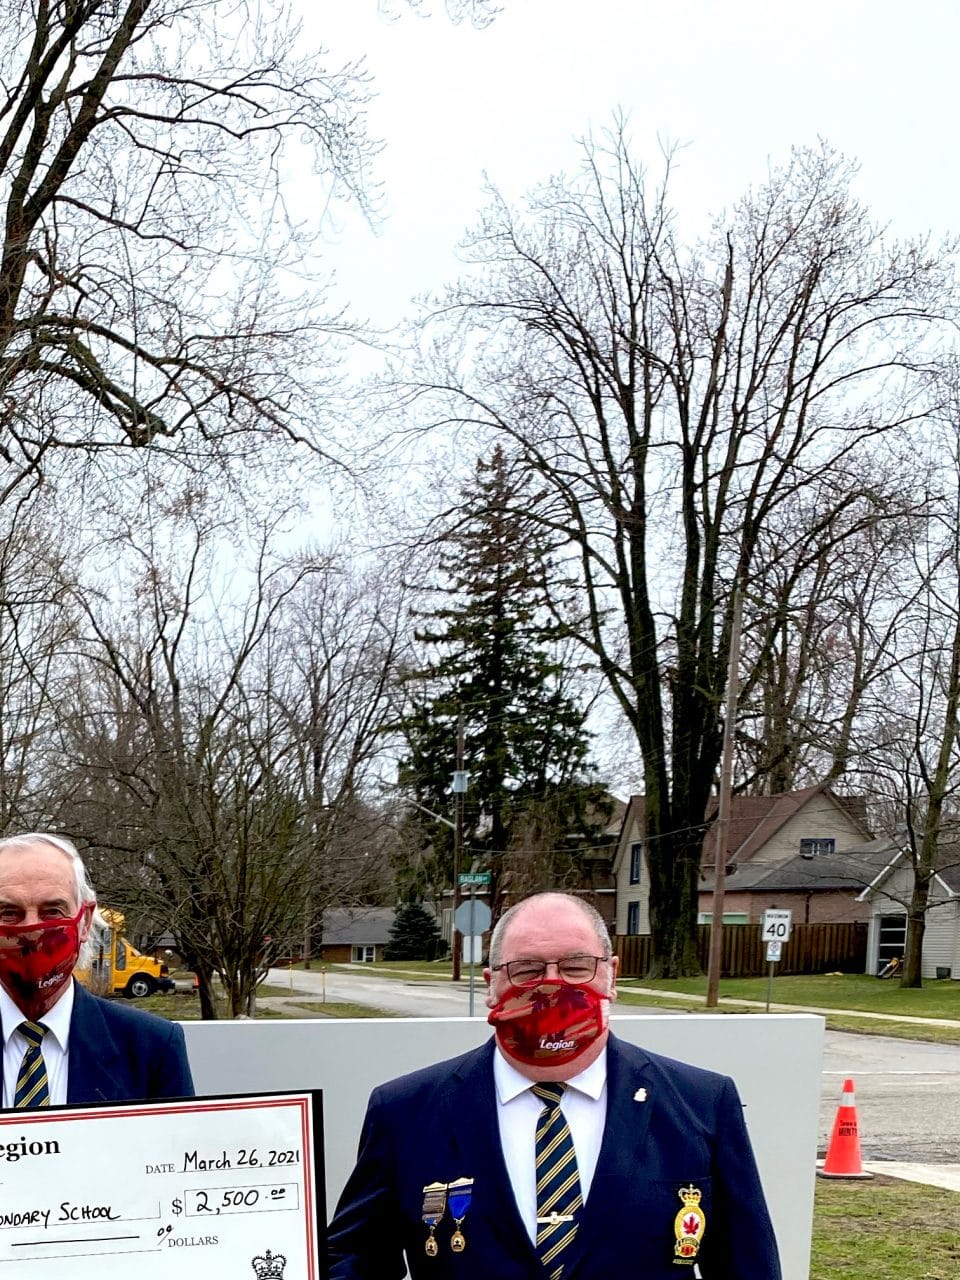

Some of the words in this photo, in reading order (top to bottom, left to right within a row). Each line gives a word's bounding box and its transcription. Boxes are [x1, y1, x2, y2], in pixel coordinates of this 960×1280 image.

[766, 923, 786, 937] 40
[38, 973, 64, 989] Legion
[540, 1039, 575, 1052] Legion
[183, 1151, 231, 1172] March
[268, 1149, 299, 1165] 2021
[145, 1163, 175, 1174] DATE
[58, 1202, 122, 1221] SCHOOL
[172, 1198, 183, 1216] $
[168, 1235, 219, 1247] DOLLARS
